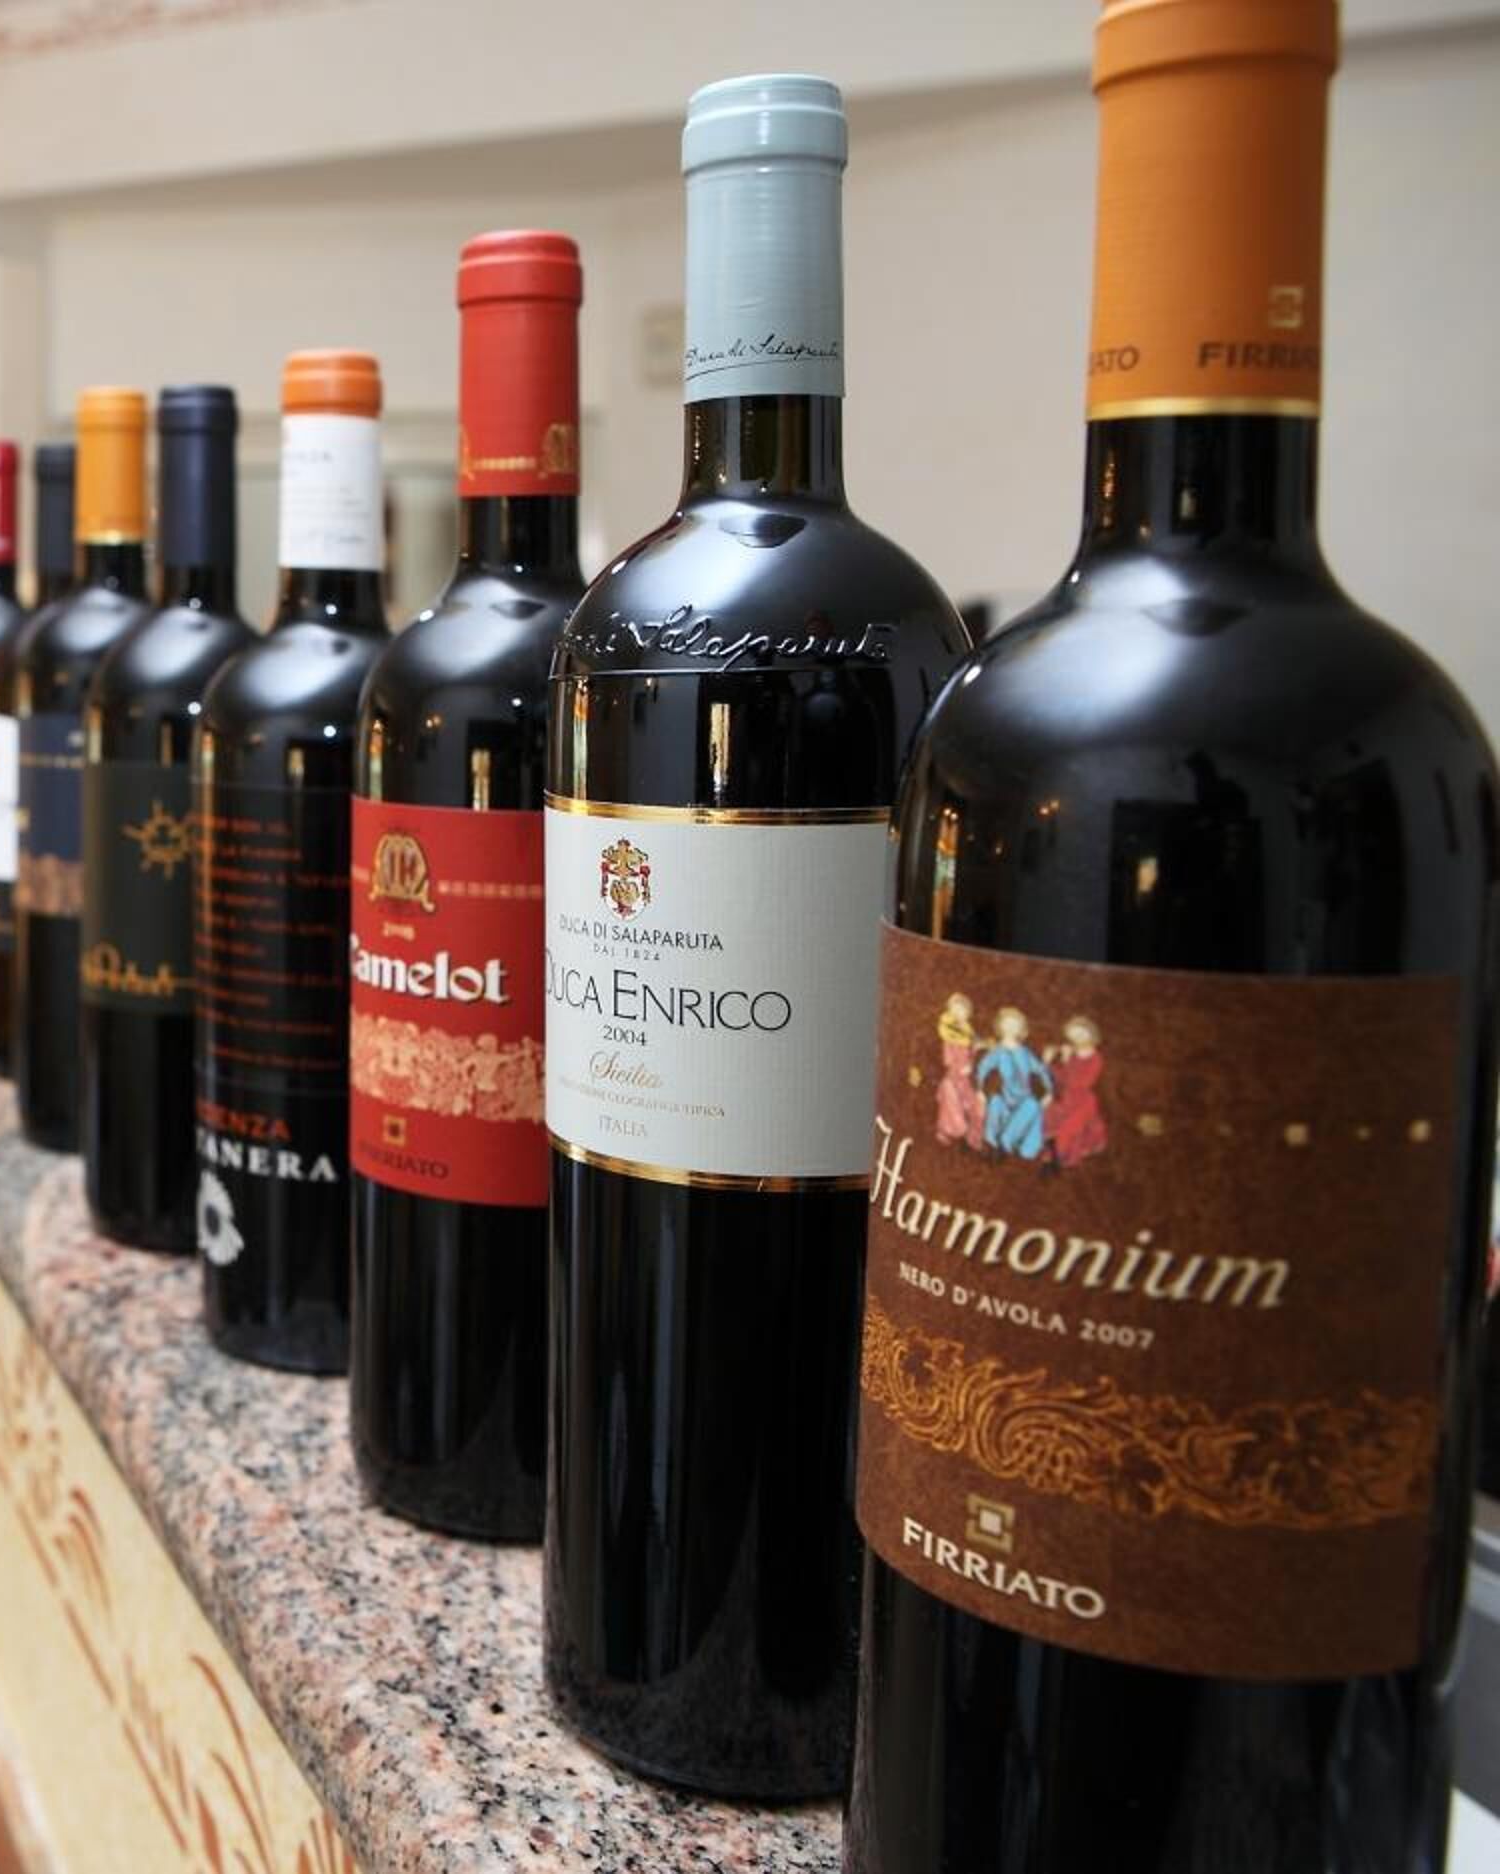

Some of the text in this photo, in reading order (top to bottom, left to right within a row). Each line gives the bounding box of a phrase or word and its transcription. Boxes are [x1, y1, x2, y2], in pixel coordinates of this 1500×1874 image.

[593, 921, 607, 940] DI
[611, 925, 724, 951] SALAPARUTA
[603, 1025, 648, 1046] 2004
[612, 969, 792, 1032] ENRICO
[870, 1115, 1291, 1309] Harmonium
[899, 1260, 946, 1298] NERO
[1079, 1317, 1155, 1351] 2007
[901, 1515, 1107, 1620] FIRRIATO
